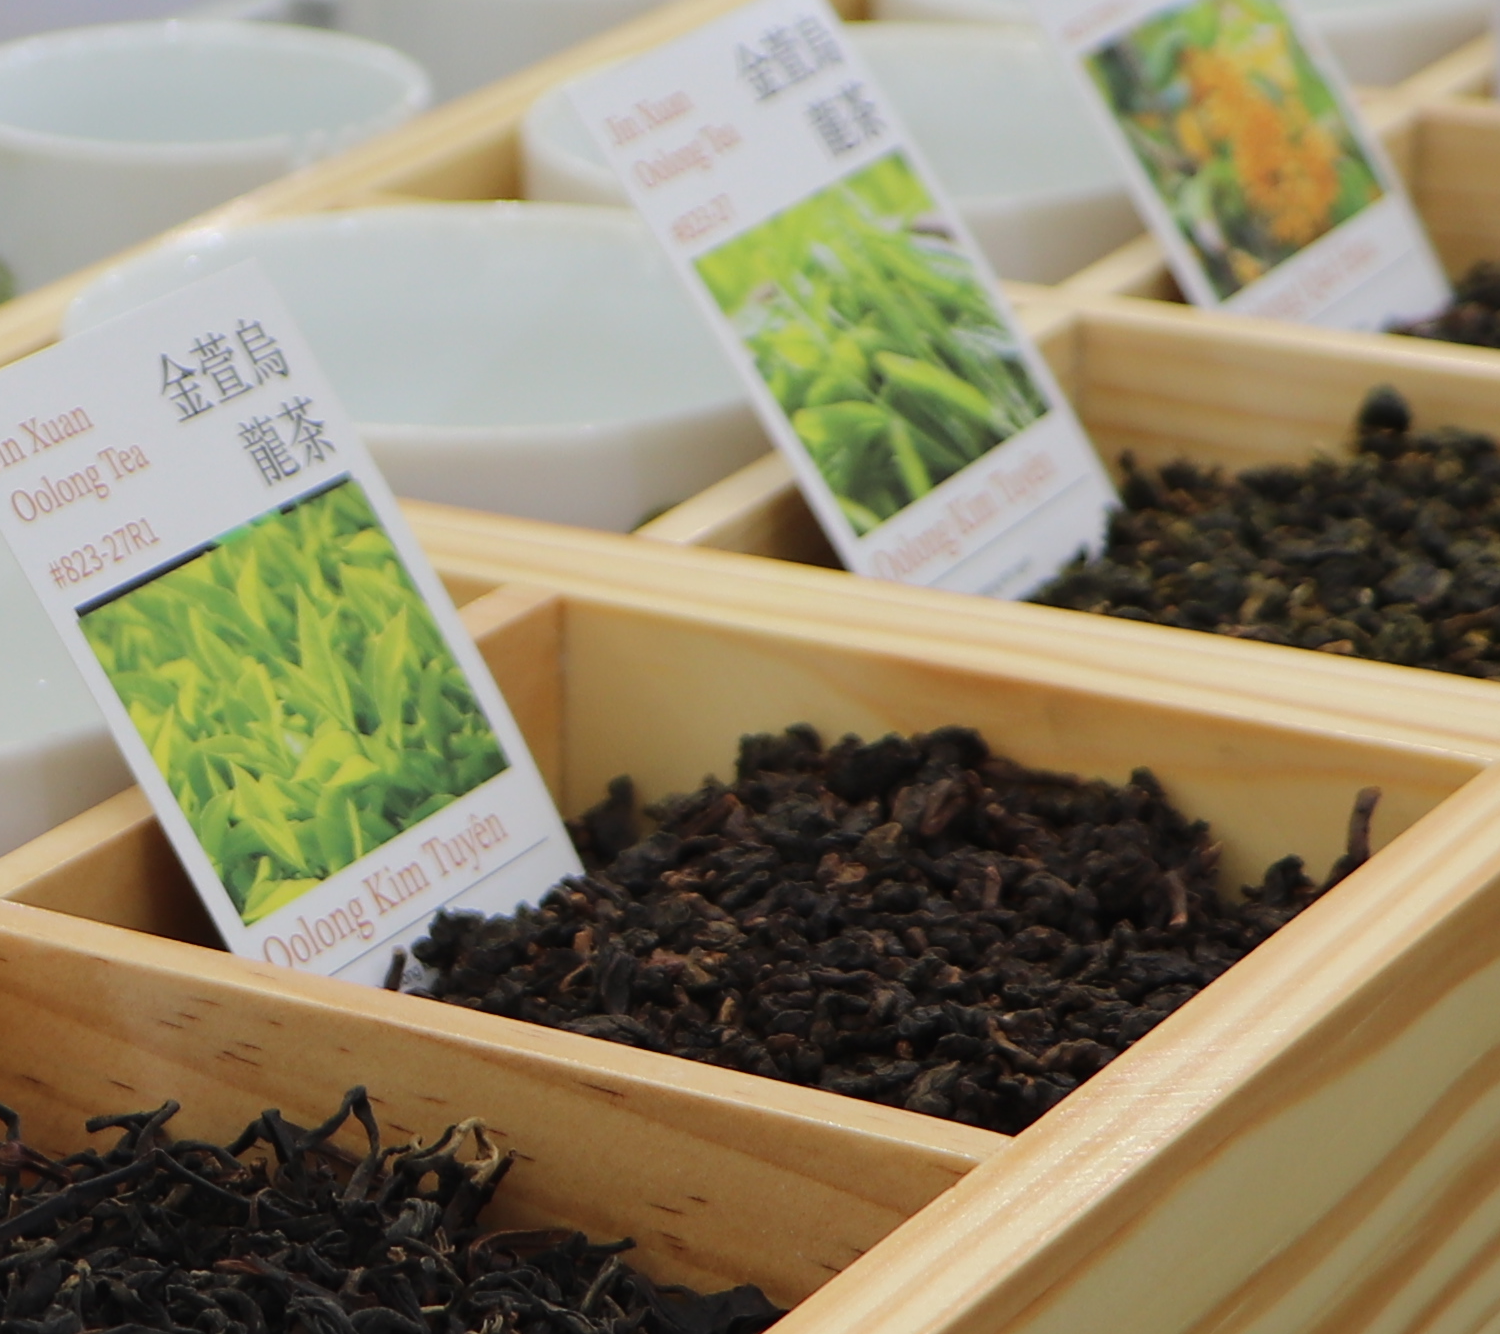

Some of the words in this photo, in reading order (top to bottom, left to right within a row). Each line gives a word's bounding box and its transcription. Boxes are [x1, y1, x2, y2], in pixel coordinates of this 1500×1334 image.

[18, 407, 95, 454] Xuan
[238, 396, 336, 487] 龍茶
[10, 465, 110, 523] Oolong
[97, 444, 150, 479] Tea
[49, 518, 160, 589] #823-27R1
[263, 896, 375, 967] Oolong
[362, 861, 432, 916] Kim
[420, 813, 509, 879] Tuyên
